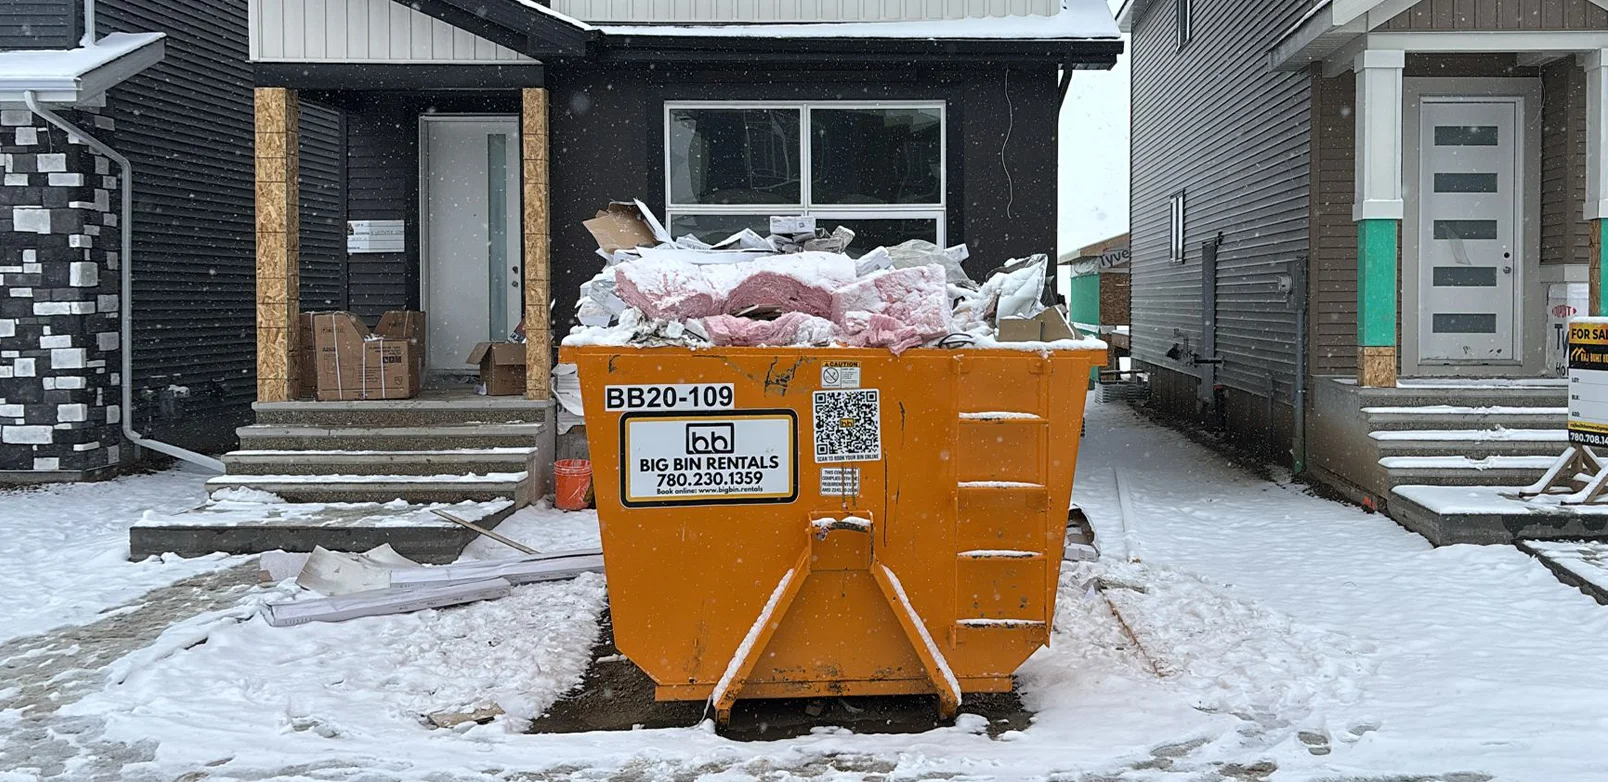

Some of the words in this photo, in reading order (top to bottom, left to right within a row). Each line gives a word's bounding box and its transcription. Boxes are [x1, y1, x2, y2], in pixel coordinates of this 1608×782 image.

[1571, 328, 1591, 340] FOR
[606, 386, 733, 409] BB20-109
[640, 458, 669, 472] BIG
[673, 457, 701, 471] BIN
[706, 455, 779, 470] RENTALS
[657, 471, 763, 487] 780.230.1359
[657, 487, 673, 495] Book
[698, 485, 763, 495] www.bigbin.rentals
